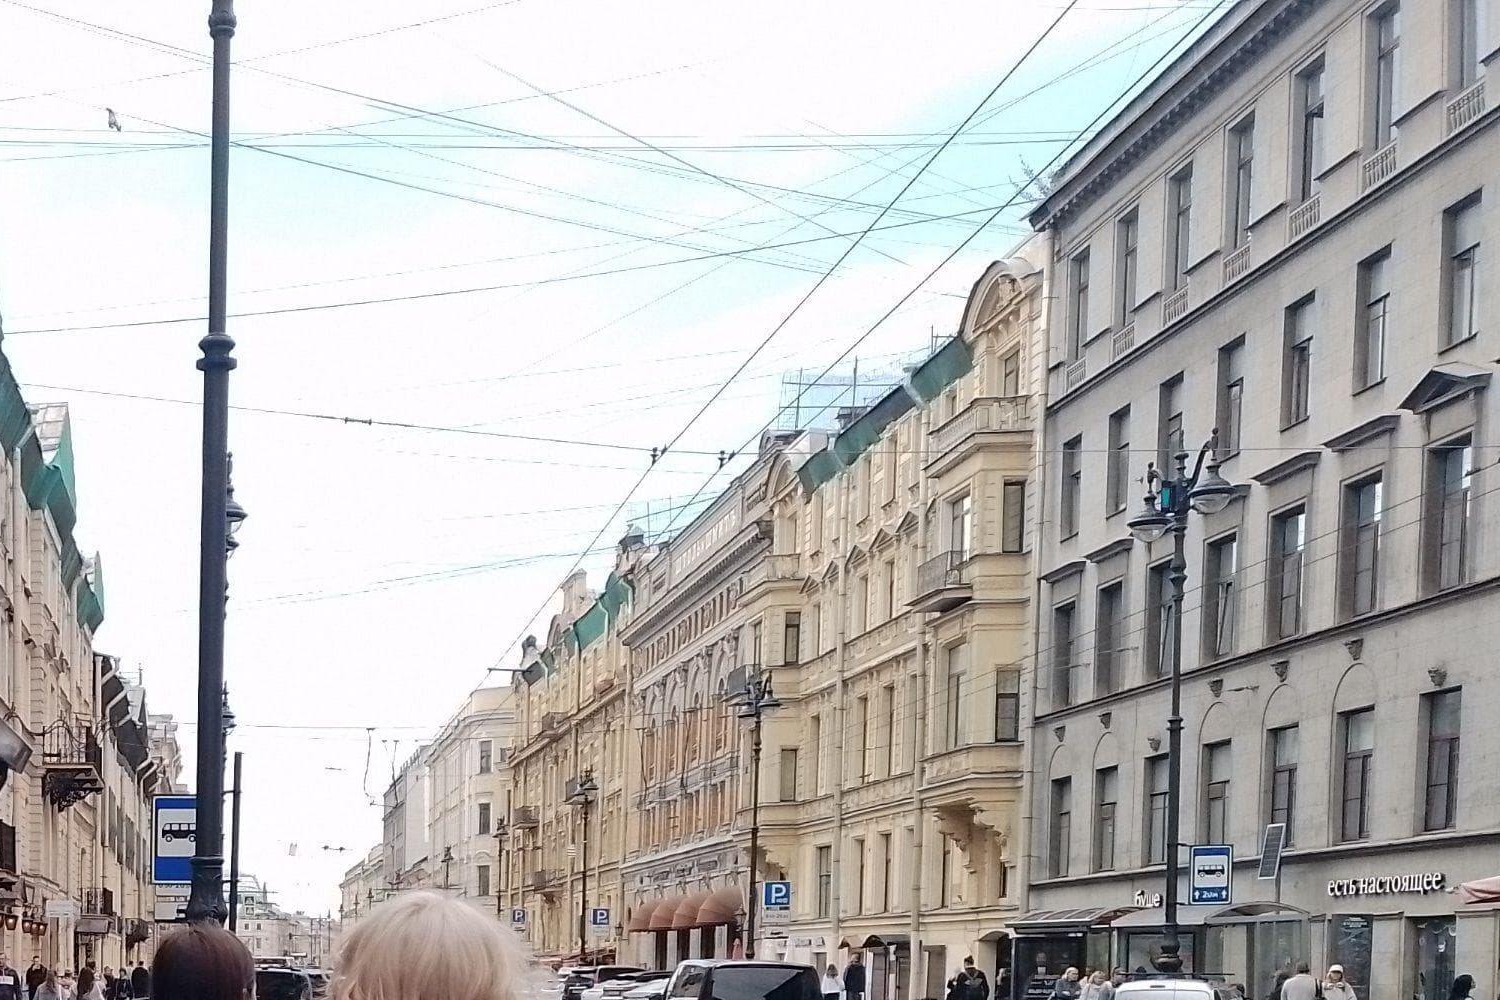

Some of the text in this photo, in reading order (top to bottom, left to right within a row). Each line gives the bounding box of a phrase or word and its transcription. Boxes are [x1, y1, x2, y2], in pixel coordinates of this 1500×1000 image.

[1328, 872, 1442, 896] есть настоящее
[1135, 890, 1161, 907] буше
